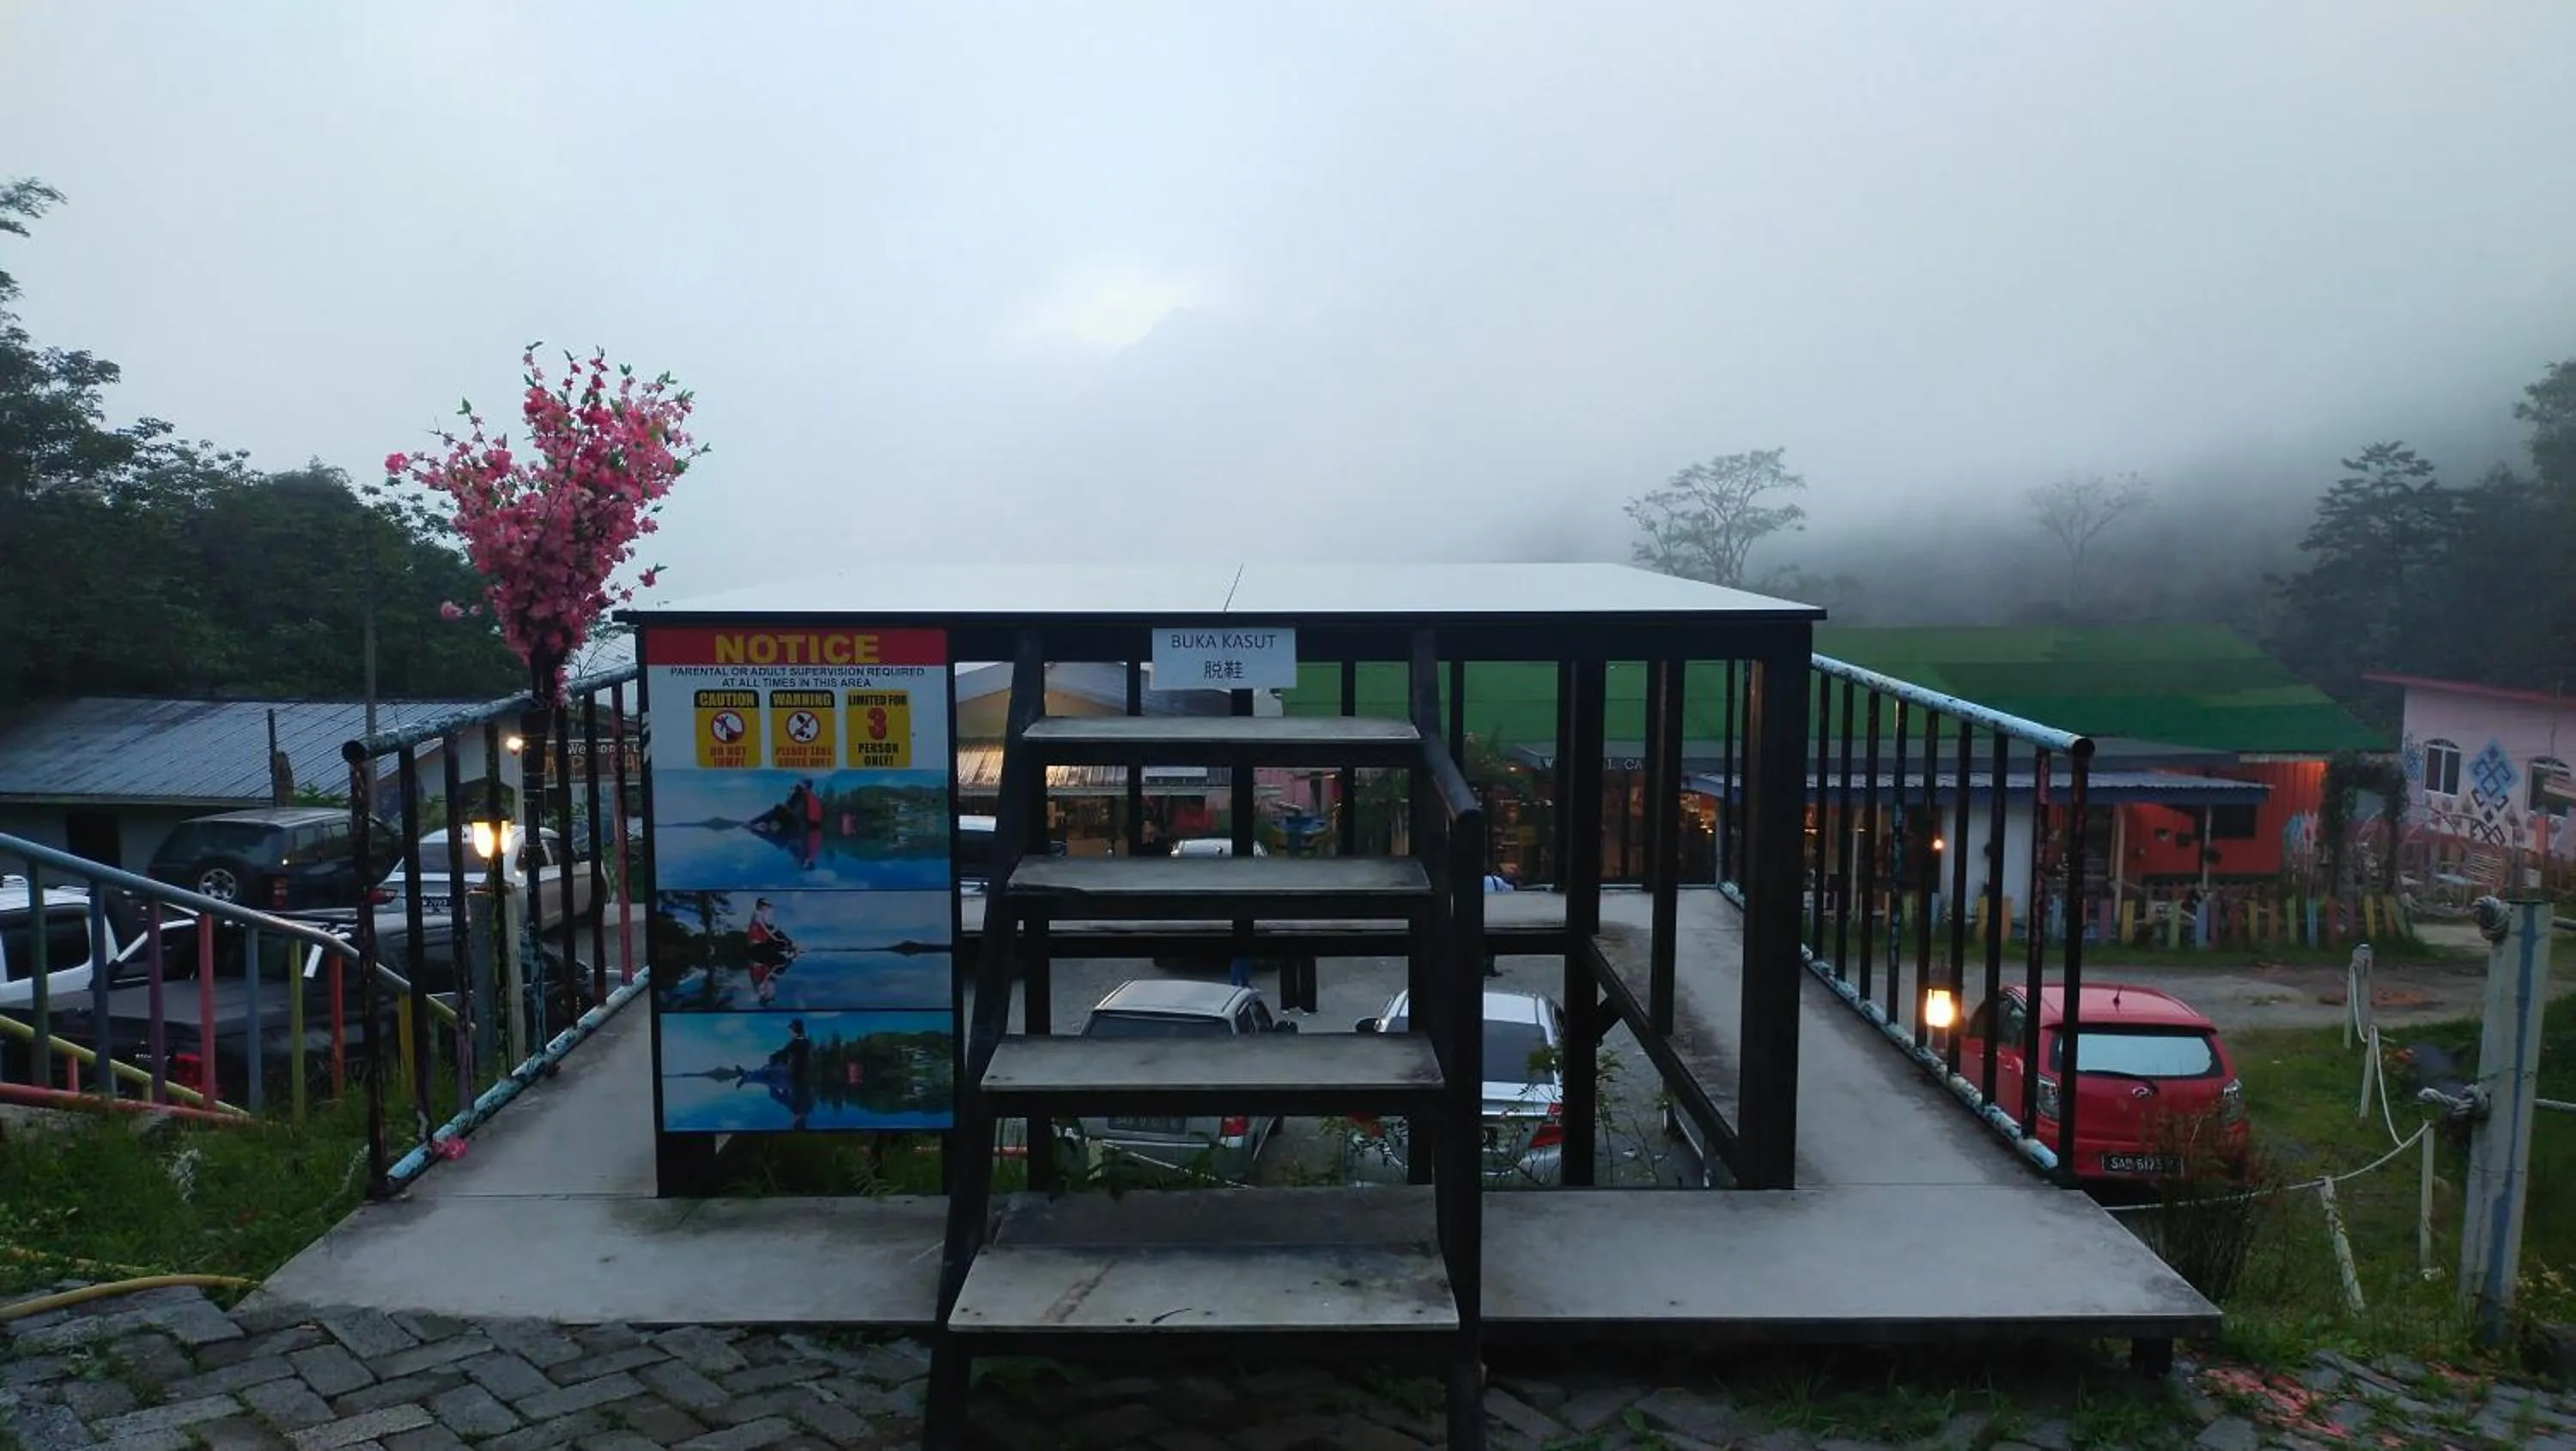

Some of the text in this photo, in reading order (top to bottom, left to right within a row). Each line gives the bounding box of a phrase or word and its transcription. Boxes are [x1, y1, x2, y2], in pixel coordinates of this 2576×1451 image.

[1170, 634, 1277, 649] BUKA KASUT
[714, 634, 881, 664] NOTICE
[671, 666, 925, 677] PARENTAL OR ADULT SUPERVISION REQUIRED
[722, 677, 872, 688] AT ALL TIMES IN THIS AREA
[699, 692, 755, 707] CAUTION
[773, 692, 832, 707] WARNING
[848, 694, 908, 706] LIMITED FOR
[867, 707, 887, 740] 3
[858, 743, 899, 754] PERSON
[864, 755, 894, 767] ONLY!
